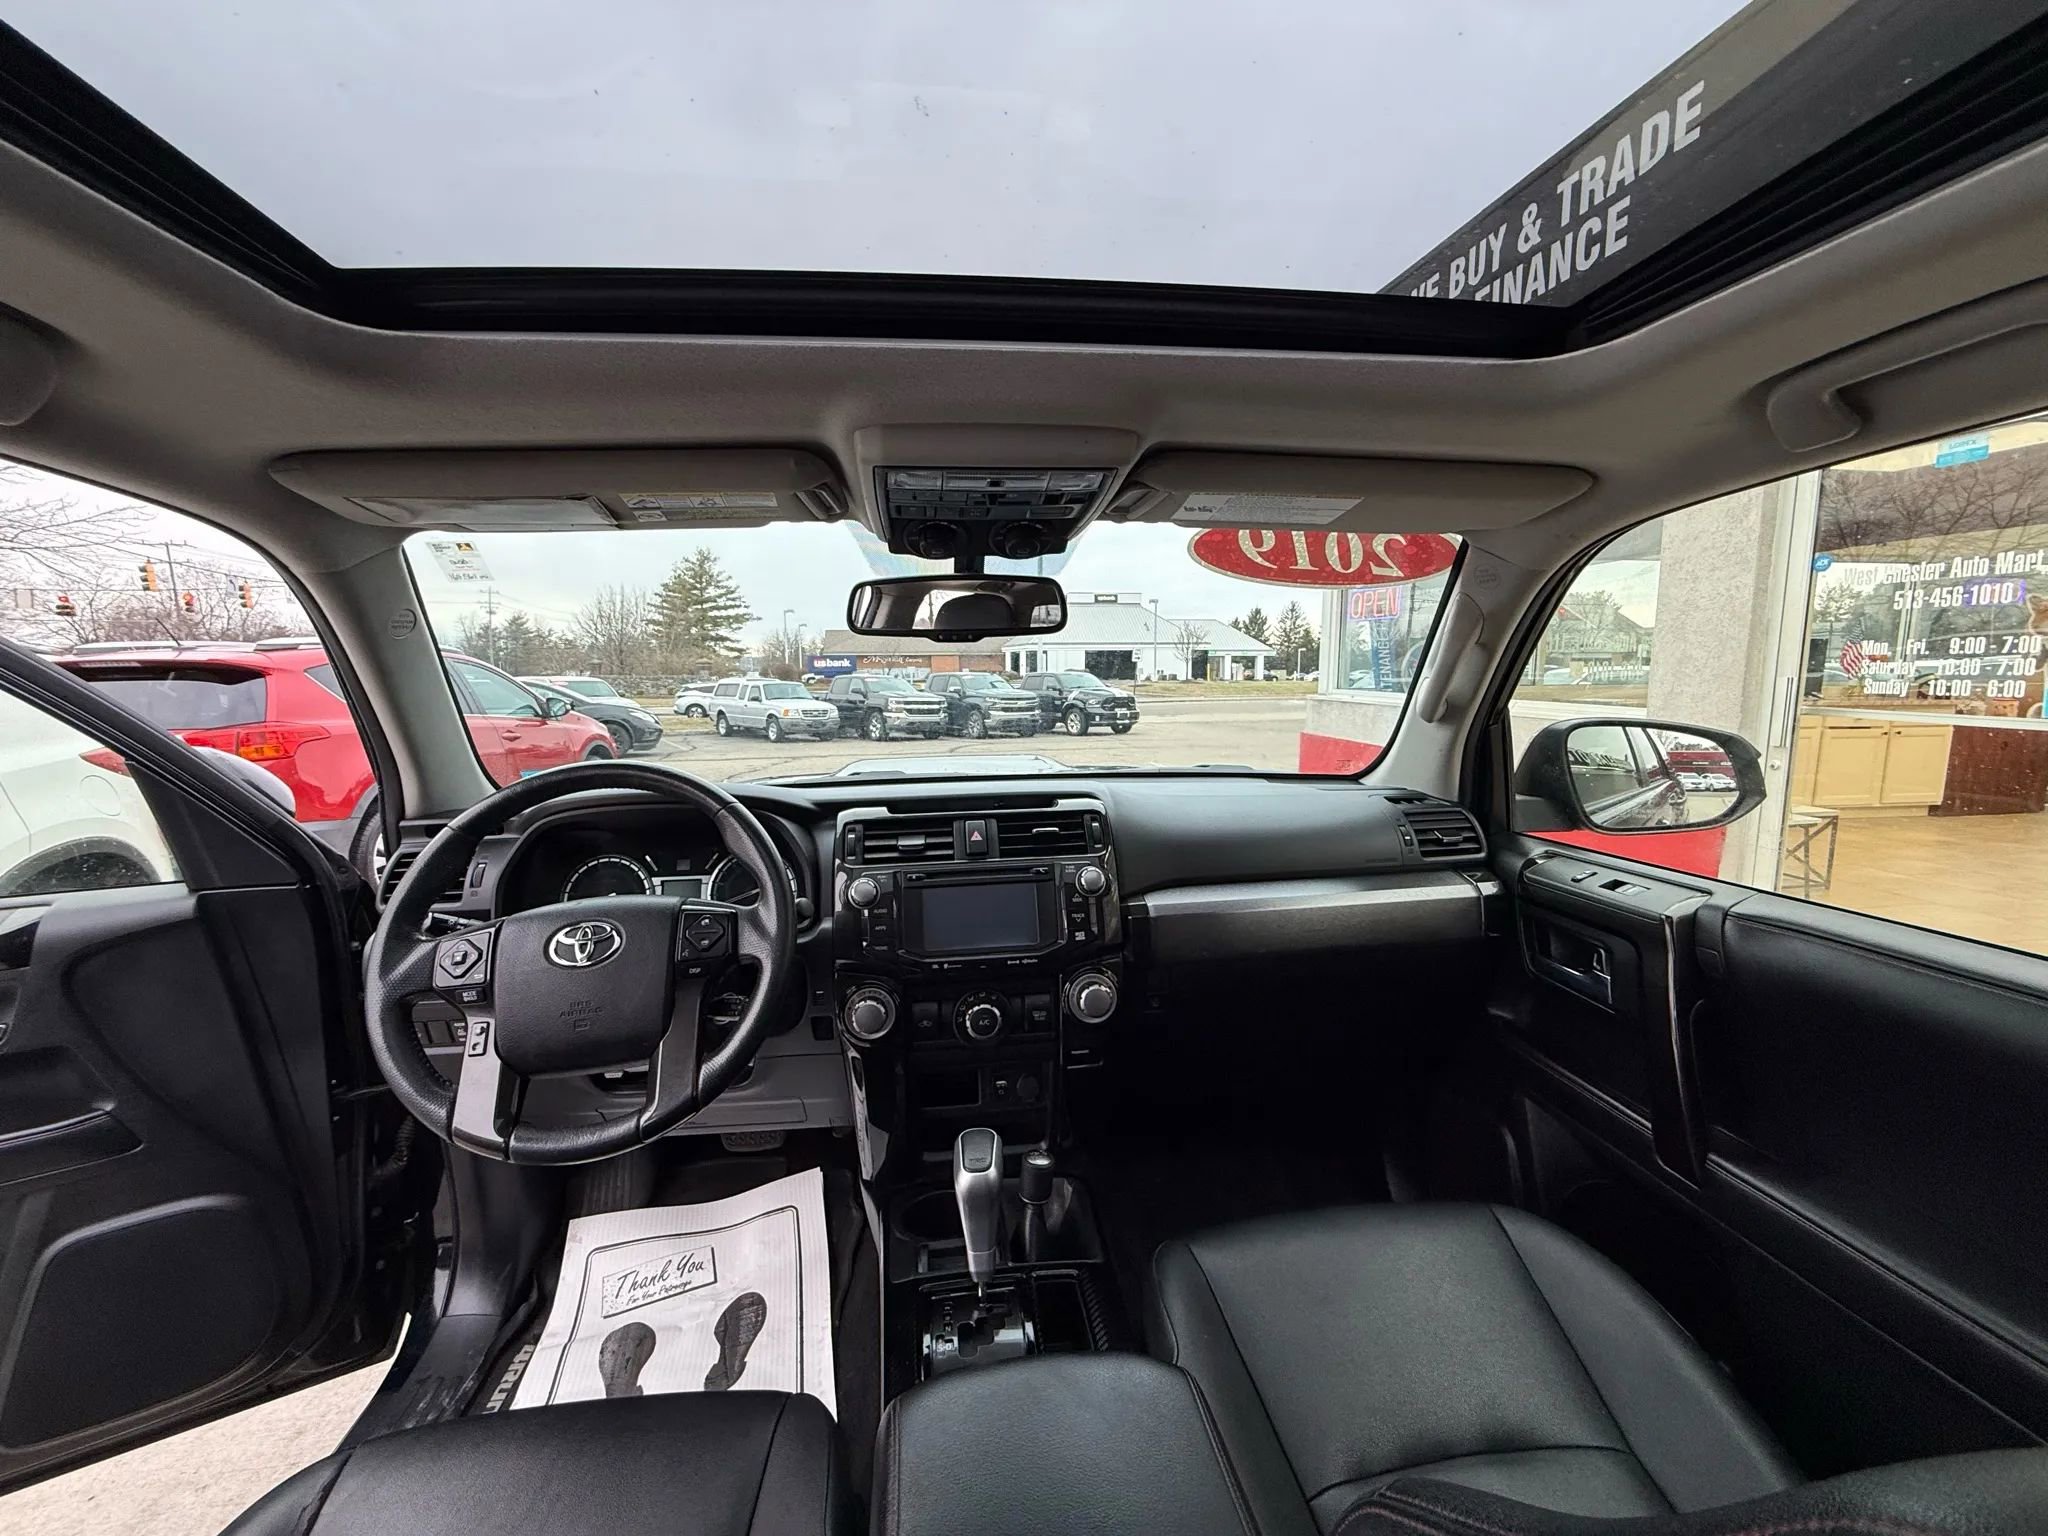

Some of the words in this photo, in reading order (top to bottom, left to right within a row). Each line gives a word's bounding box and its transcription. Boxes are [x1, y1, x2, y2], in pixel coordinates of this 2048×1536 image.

[1449, 222, 1507, 299] BUY
[1517, 202, 1542, 254] &
[1556, 79, 1704, 228] TRADE
[1844, 566, 1879, 586] West
[1949, 556, 1990, 579] Auto
[1994, 549, 2044, 575] Mart
[1351, 588, 1400, 619] OPEN
[1893, 582, 2014, 610] 513-456-1010
[1861, 640, 1892, 656] Mon.
[1906, 639, 1929, 655] Fri.
[1949, 636, 1986, 654] 9:00
[2001, 635, 2041, 654] 7:00
[1861, 659, 1915, 677] Saturday
[1996, 658, 2036, 676] 7:00
[1863, 678, 1909, 697] Sunday
[1928, 680, 1971, 696] 10:00
[1987, 680, 2026, 698] 6:00
[614, 1259, 673, 1300] Thank
[676, 1252, 705, 1279] You
[641, 1290, 657, 1301] Your
